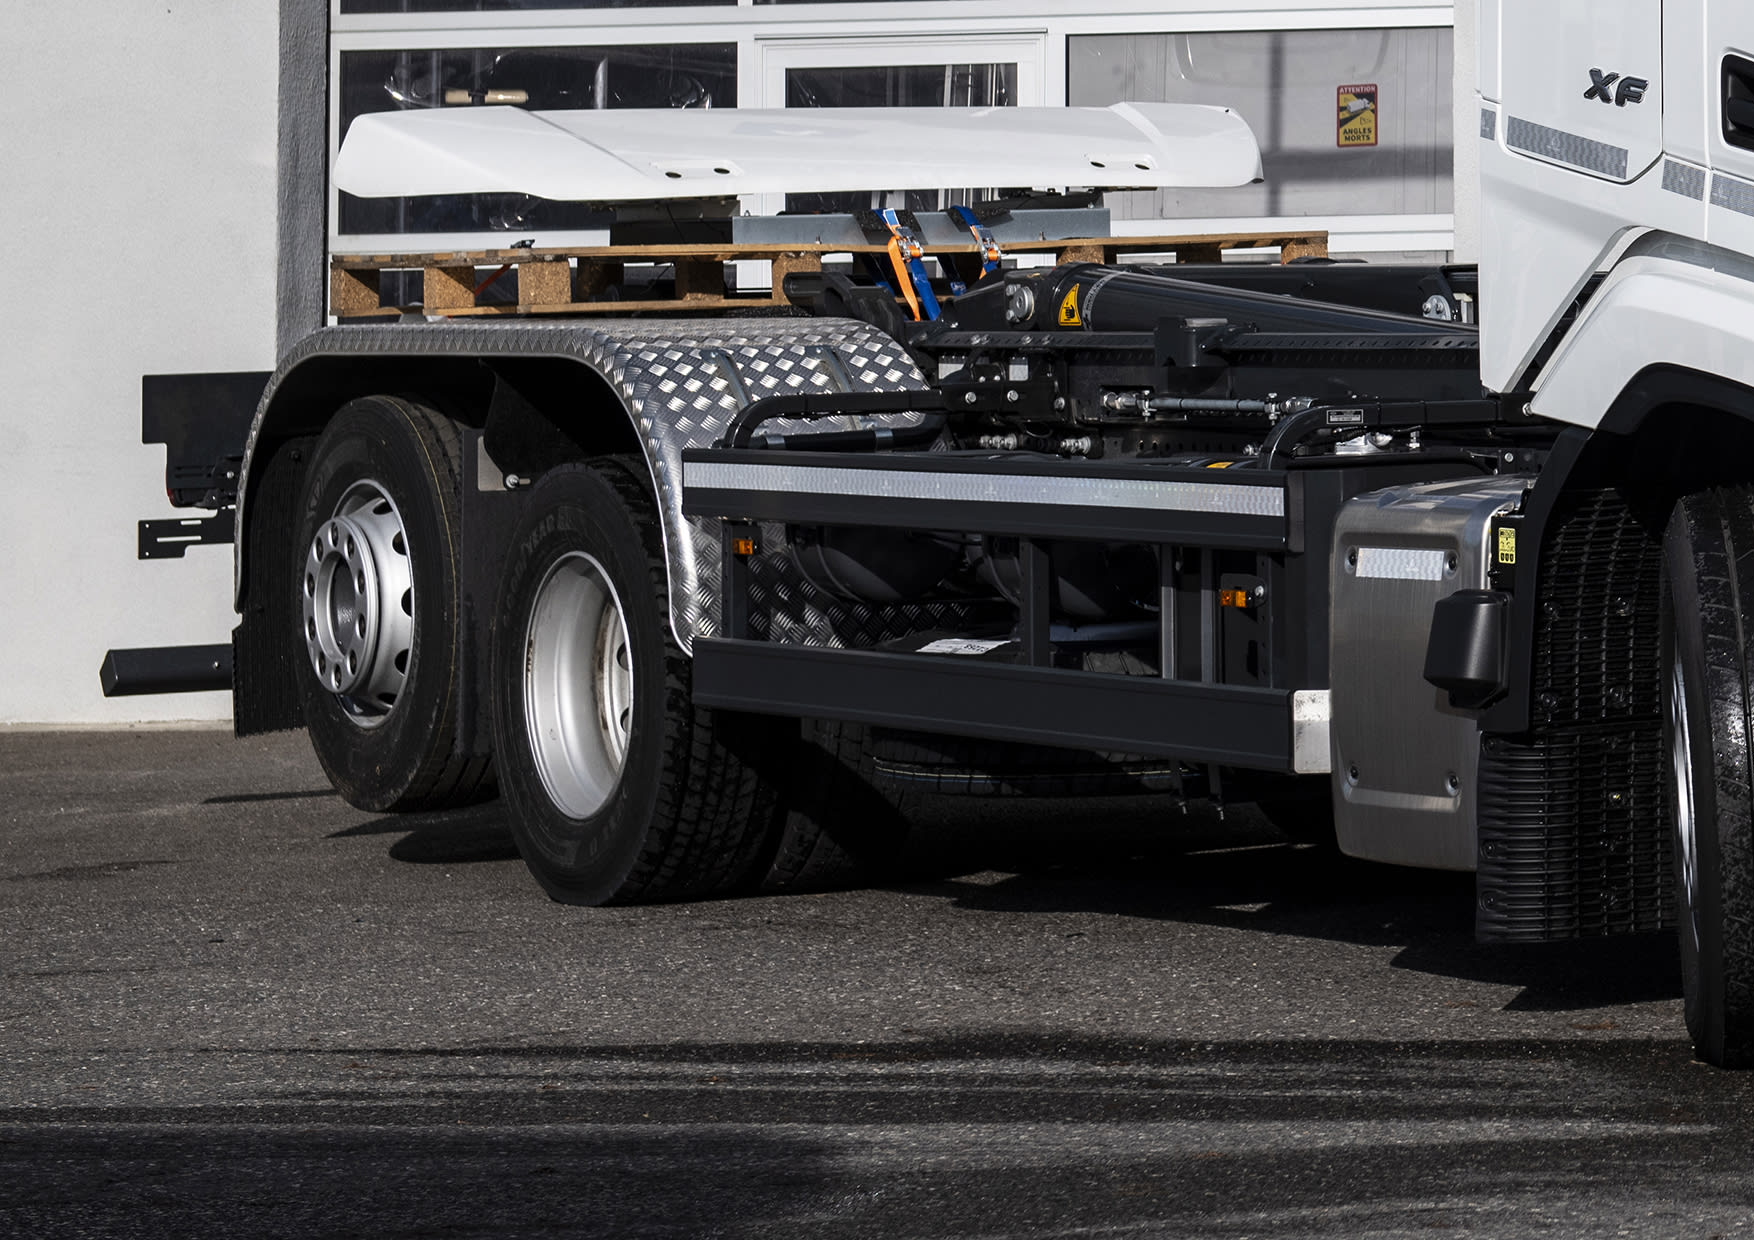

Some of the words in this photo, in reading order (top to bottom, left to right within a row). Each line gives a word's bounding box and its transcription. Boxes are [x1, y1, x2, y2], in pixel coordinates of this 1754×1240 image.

[1339, 85, 1376, 94] ATTENTION
[1583, 67, 1649, 108] XF
[1343, 127, 1372, 135] ANGLES
[1344, 134, 1371, 142] MORTS
